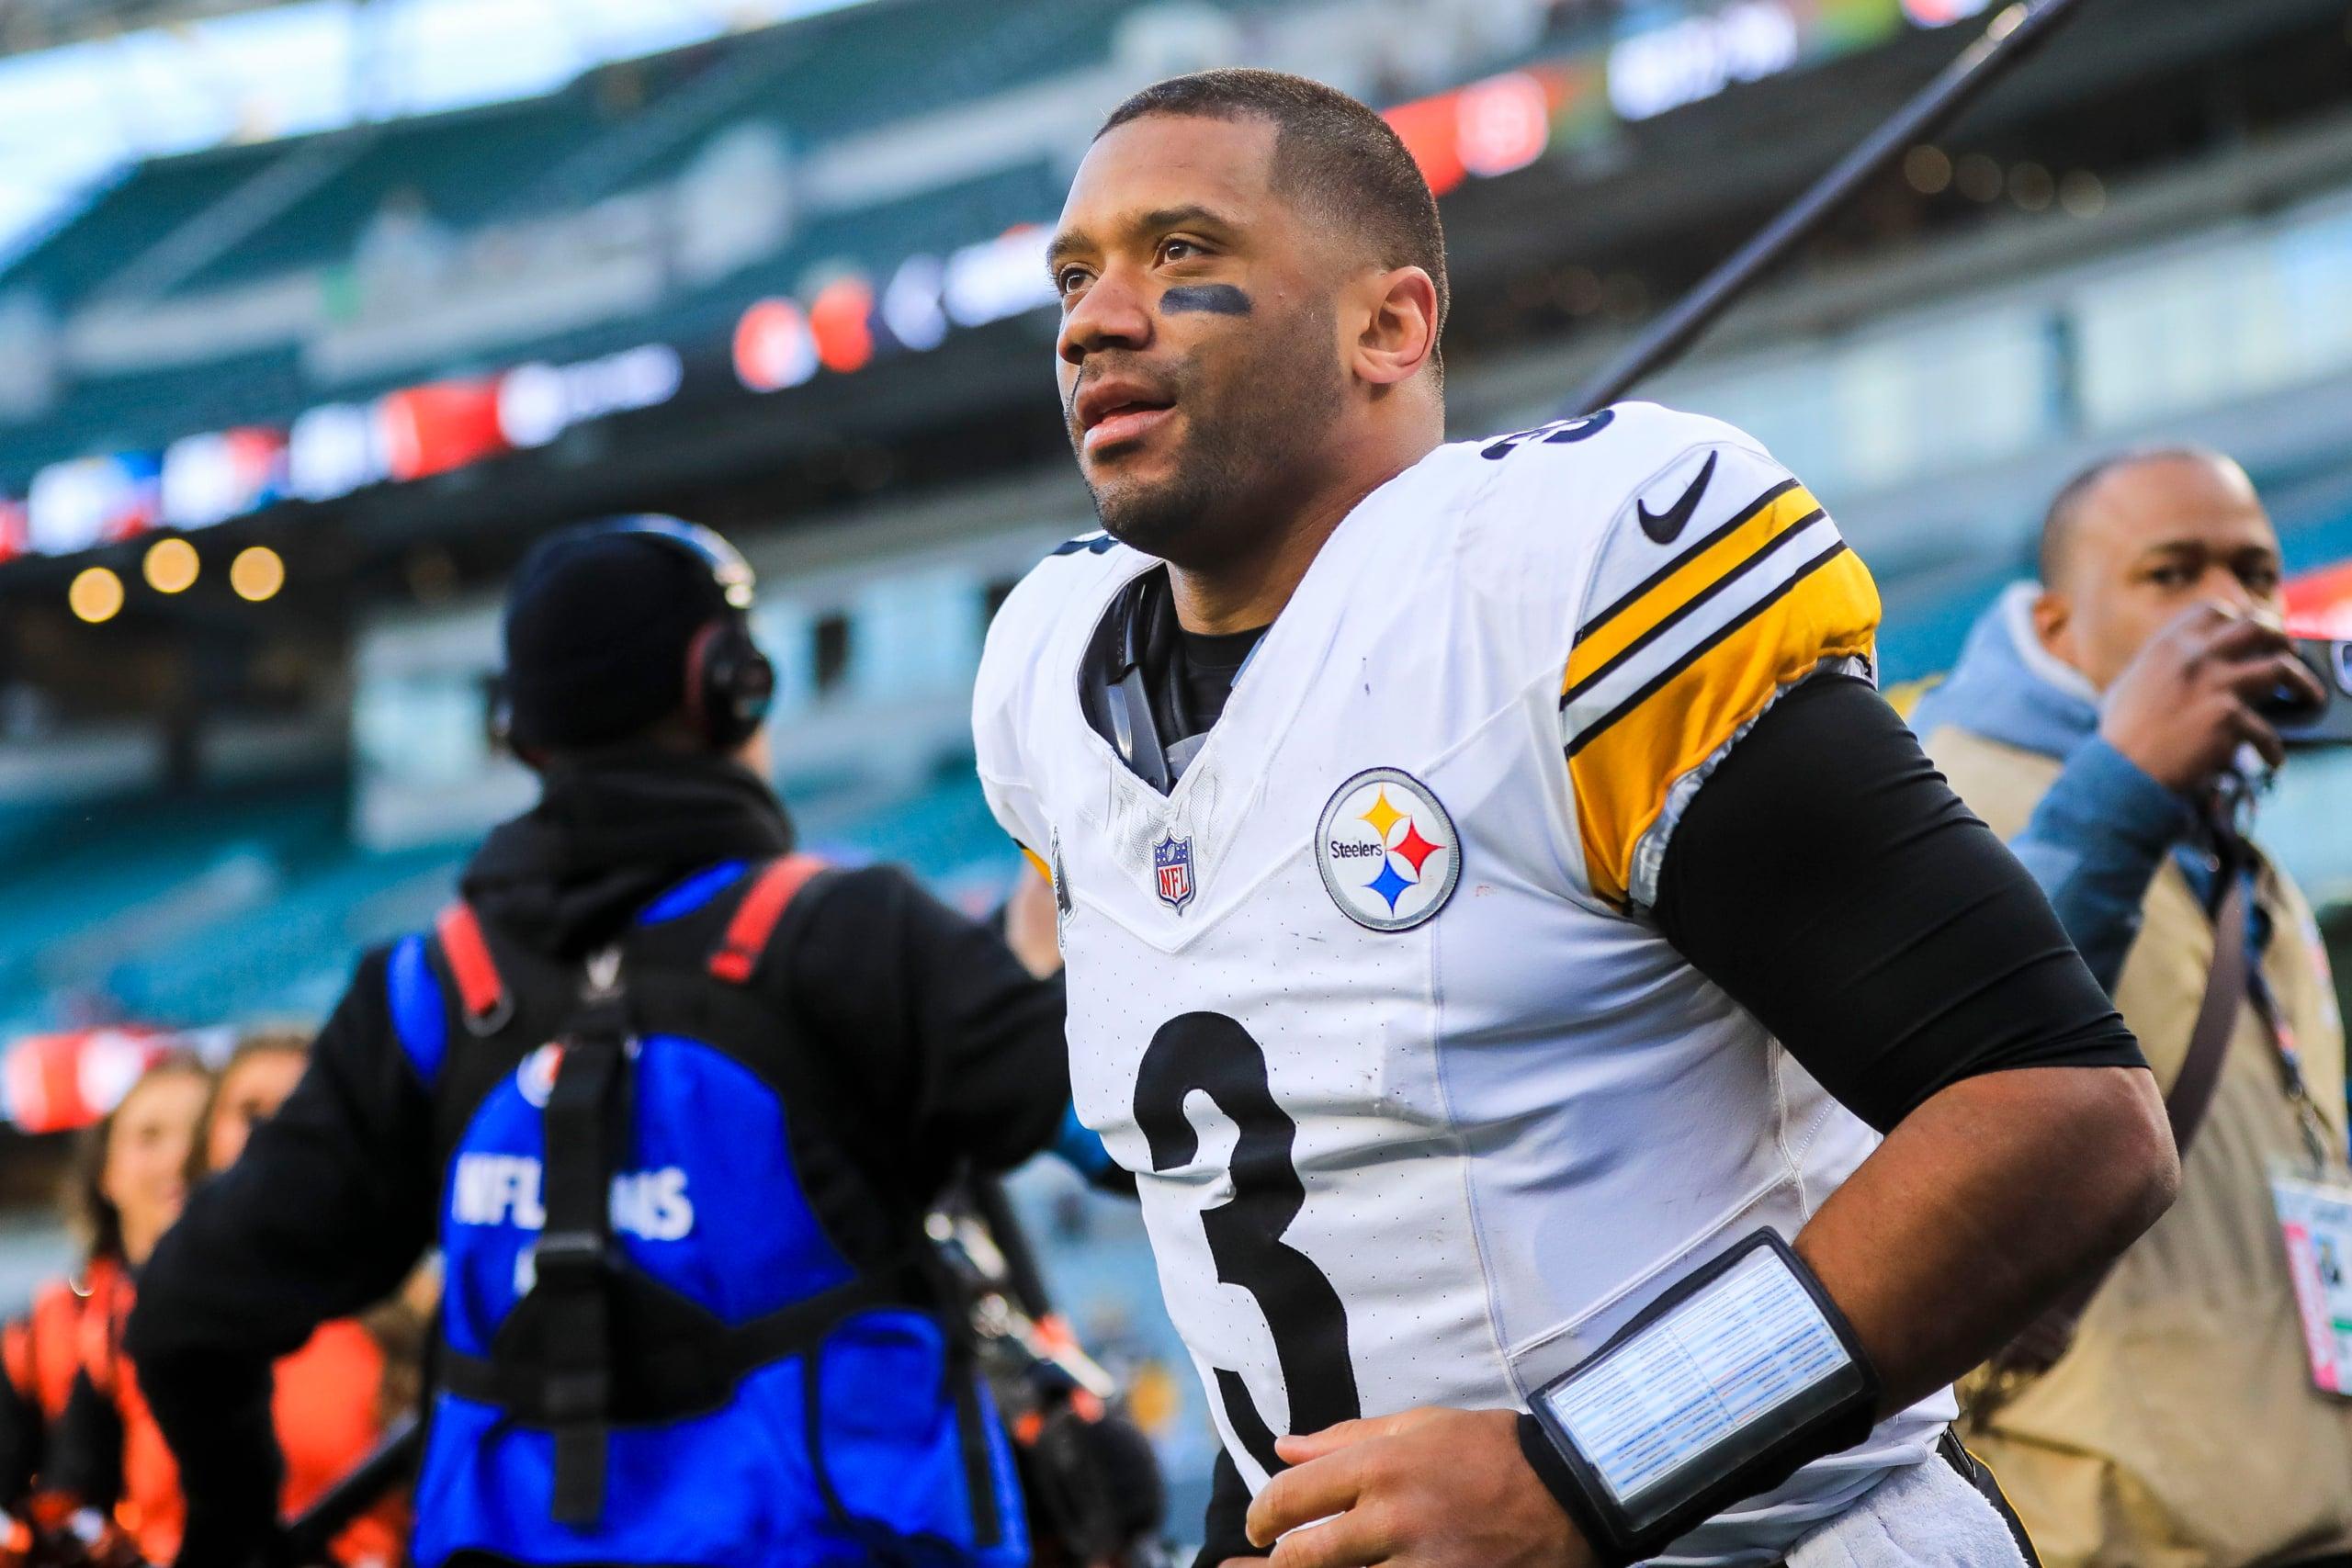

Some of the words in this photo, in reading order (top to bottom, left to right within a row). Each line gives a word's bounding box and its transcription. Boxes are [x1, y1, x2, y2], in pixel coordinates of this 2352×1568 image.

[1330, 840, 1383, 859] Steelers
[1159, 865, 1188, 899] NFL
[1133, 1010, 1361, 1477] 3
